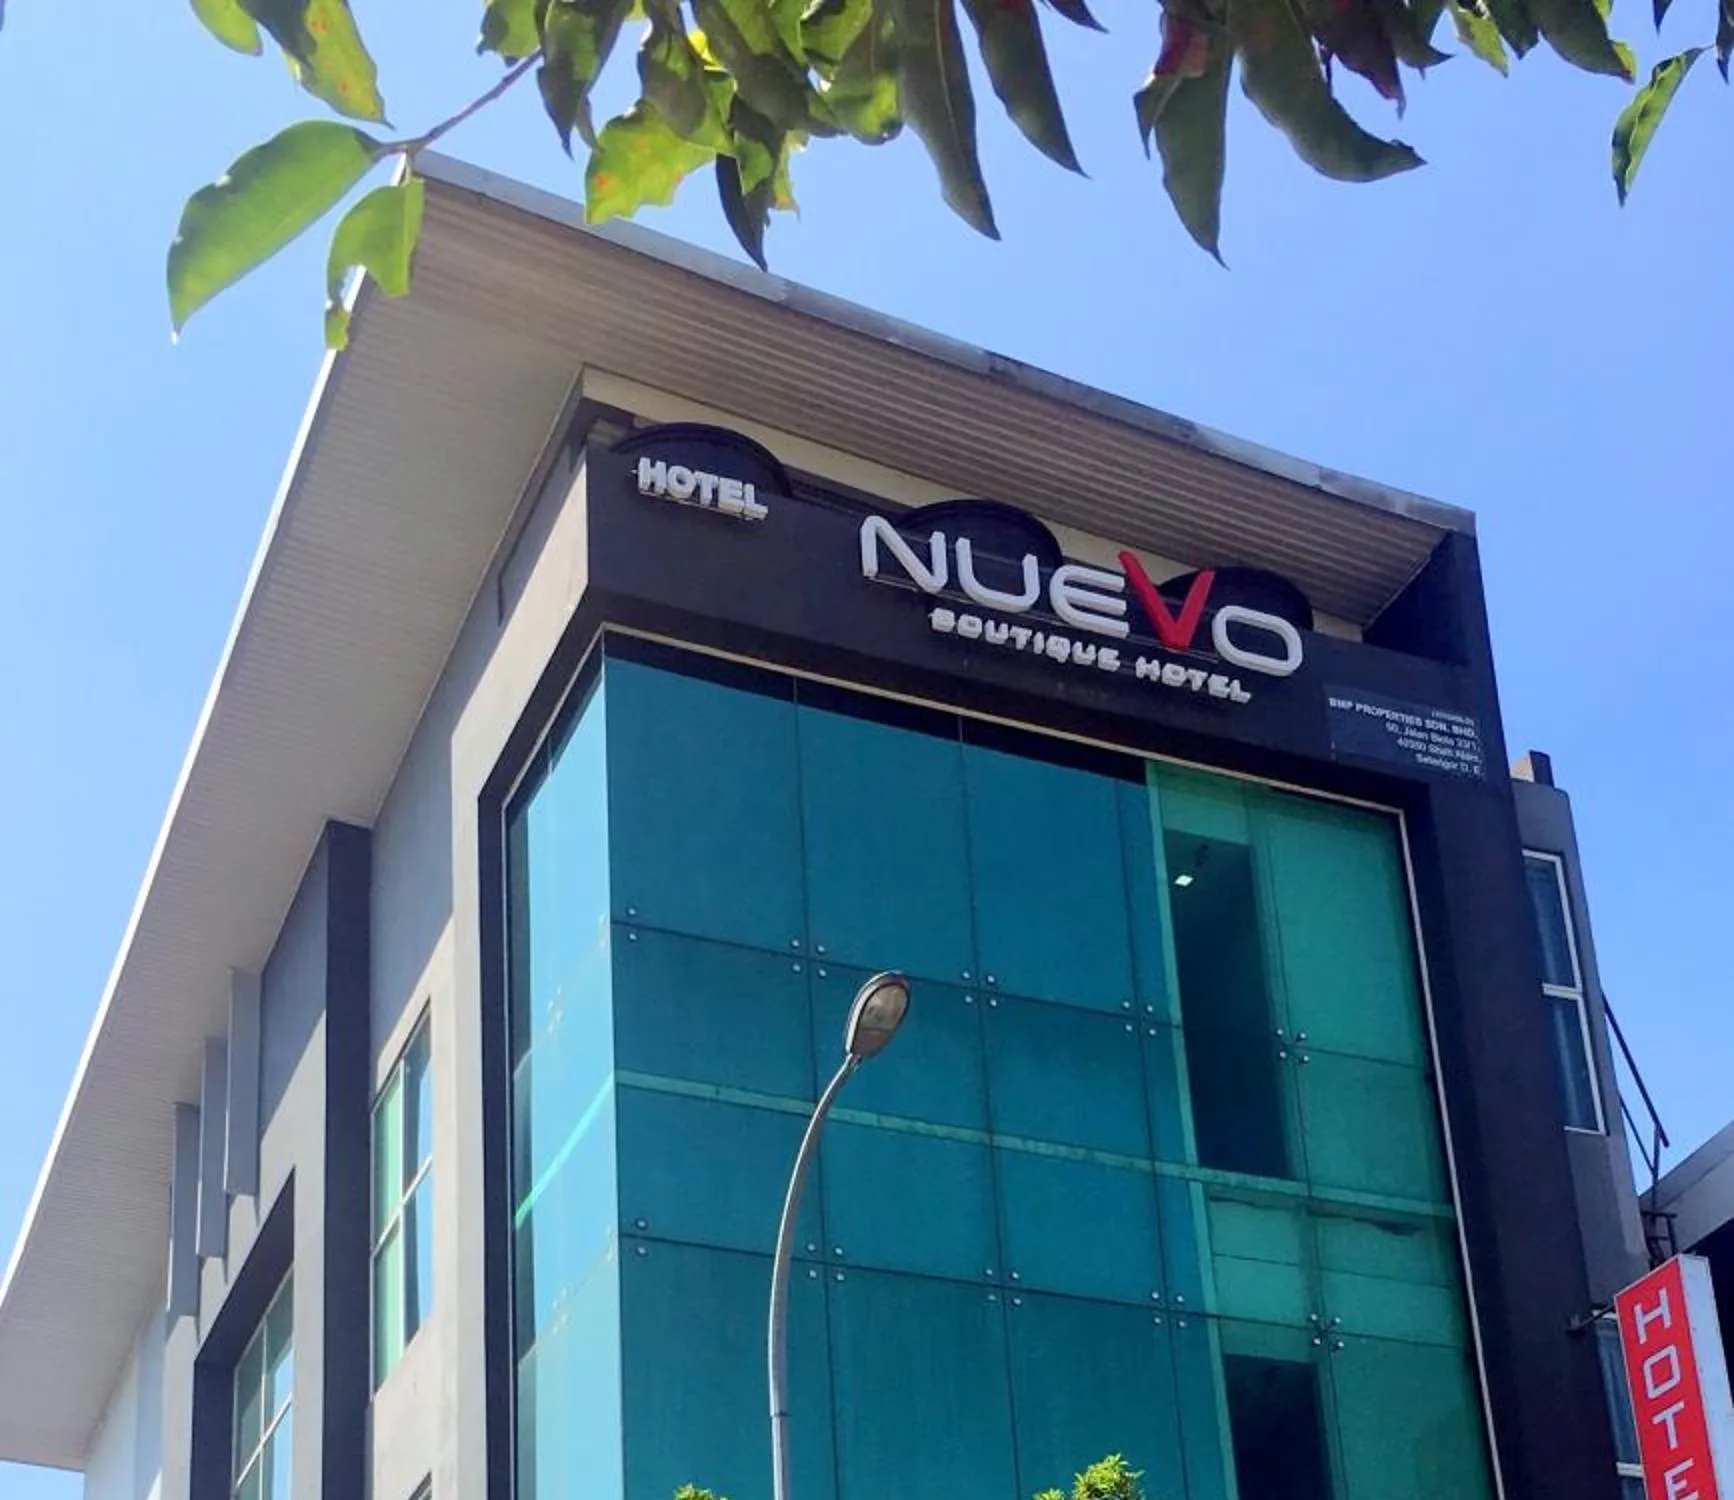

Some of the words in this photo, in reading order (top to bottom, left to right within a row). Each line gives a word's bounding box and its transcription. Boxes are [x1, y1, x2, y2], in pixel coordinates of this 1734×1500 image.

[638, 457, 768, 520] HOTEL
[861, 515, 1302, 676] NUEVO
[930, 607, 1120, 671] BOUTIQUE
[1136, 656, 1251, 704] HOTEL
[1355, 703, 1422, 727] PROPERTIES
